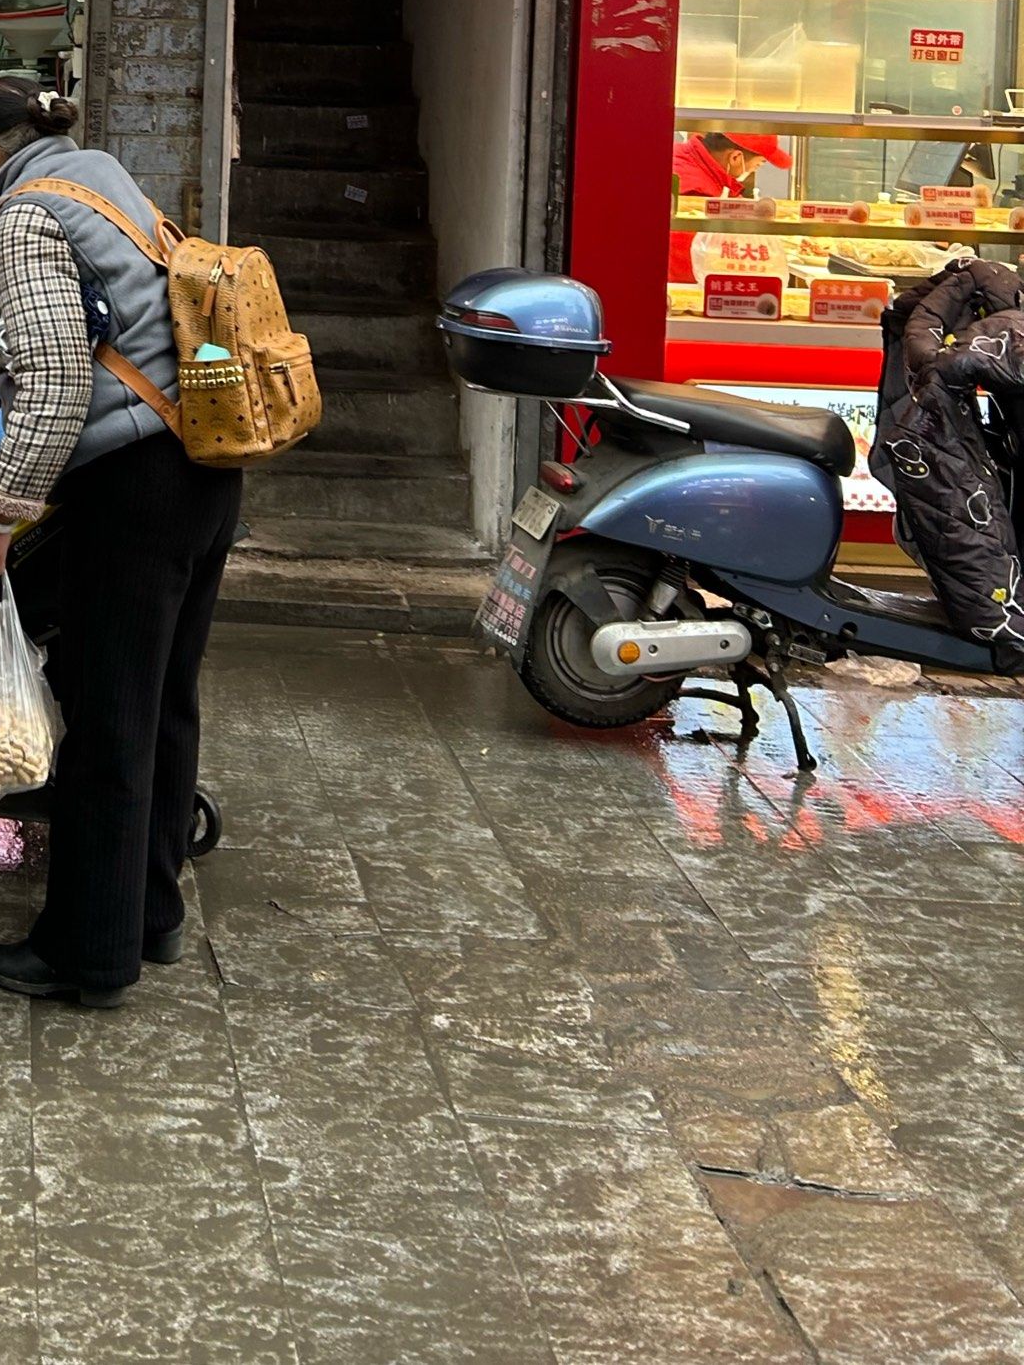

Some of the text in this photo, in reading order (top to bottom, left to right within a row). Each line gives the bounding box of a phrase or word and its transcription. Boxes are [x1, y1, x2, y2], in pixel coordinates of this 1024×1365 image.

[913, 33, 962, 46] 生食外带
[912, 48, 960, 62] 打包窗口
